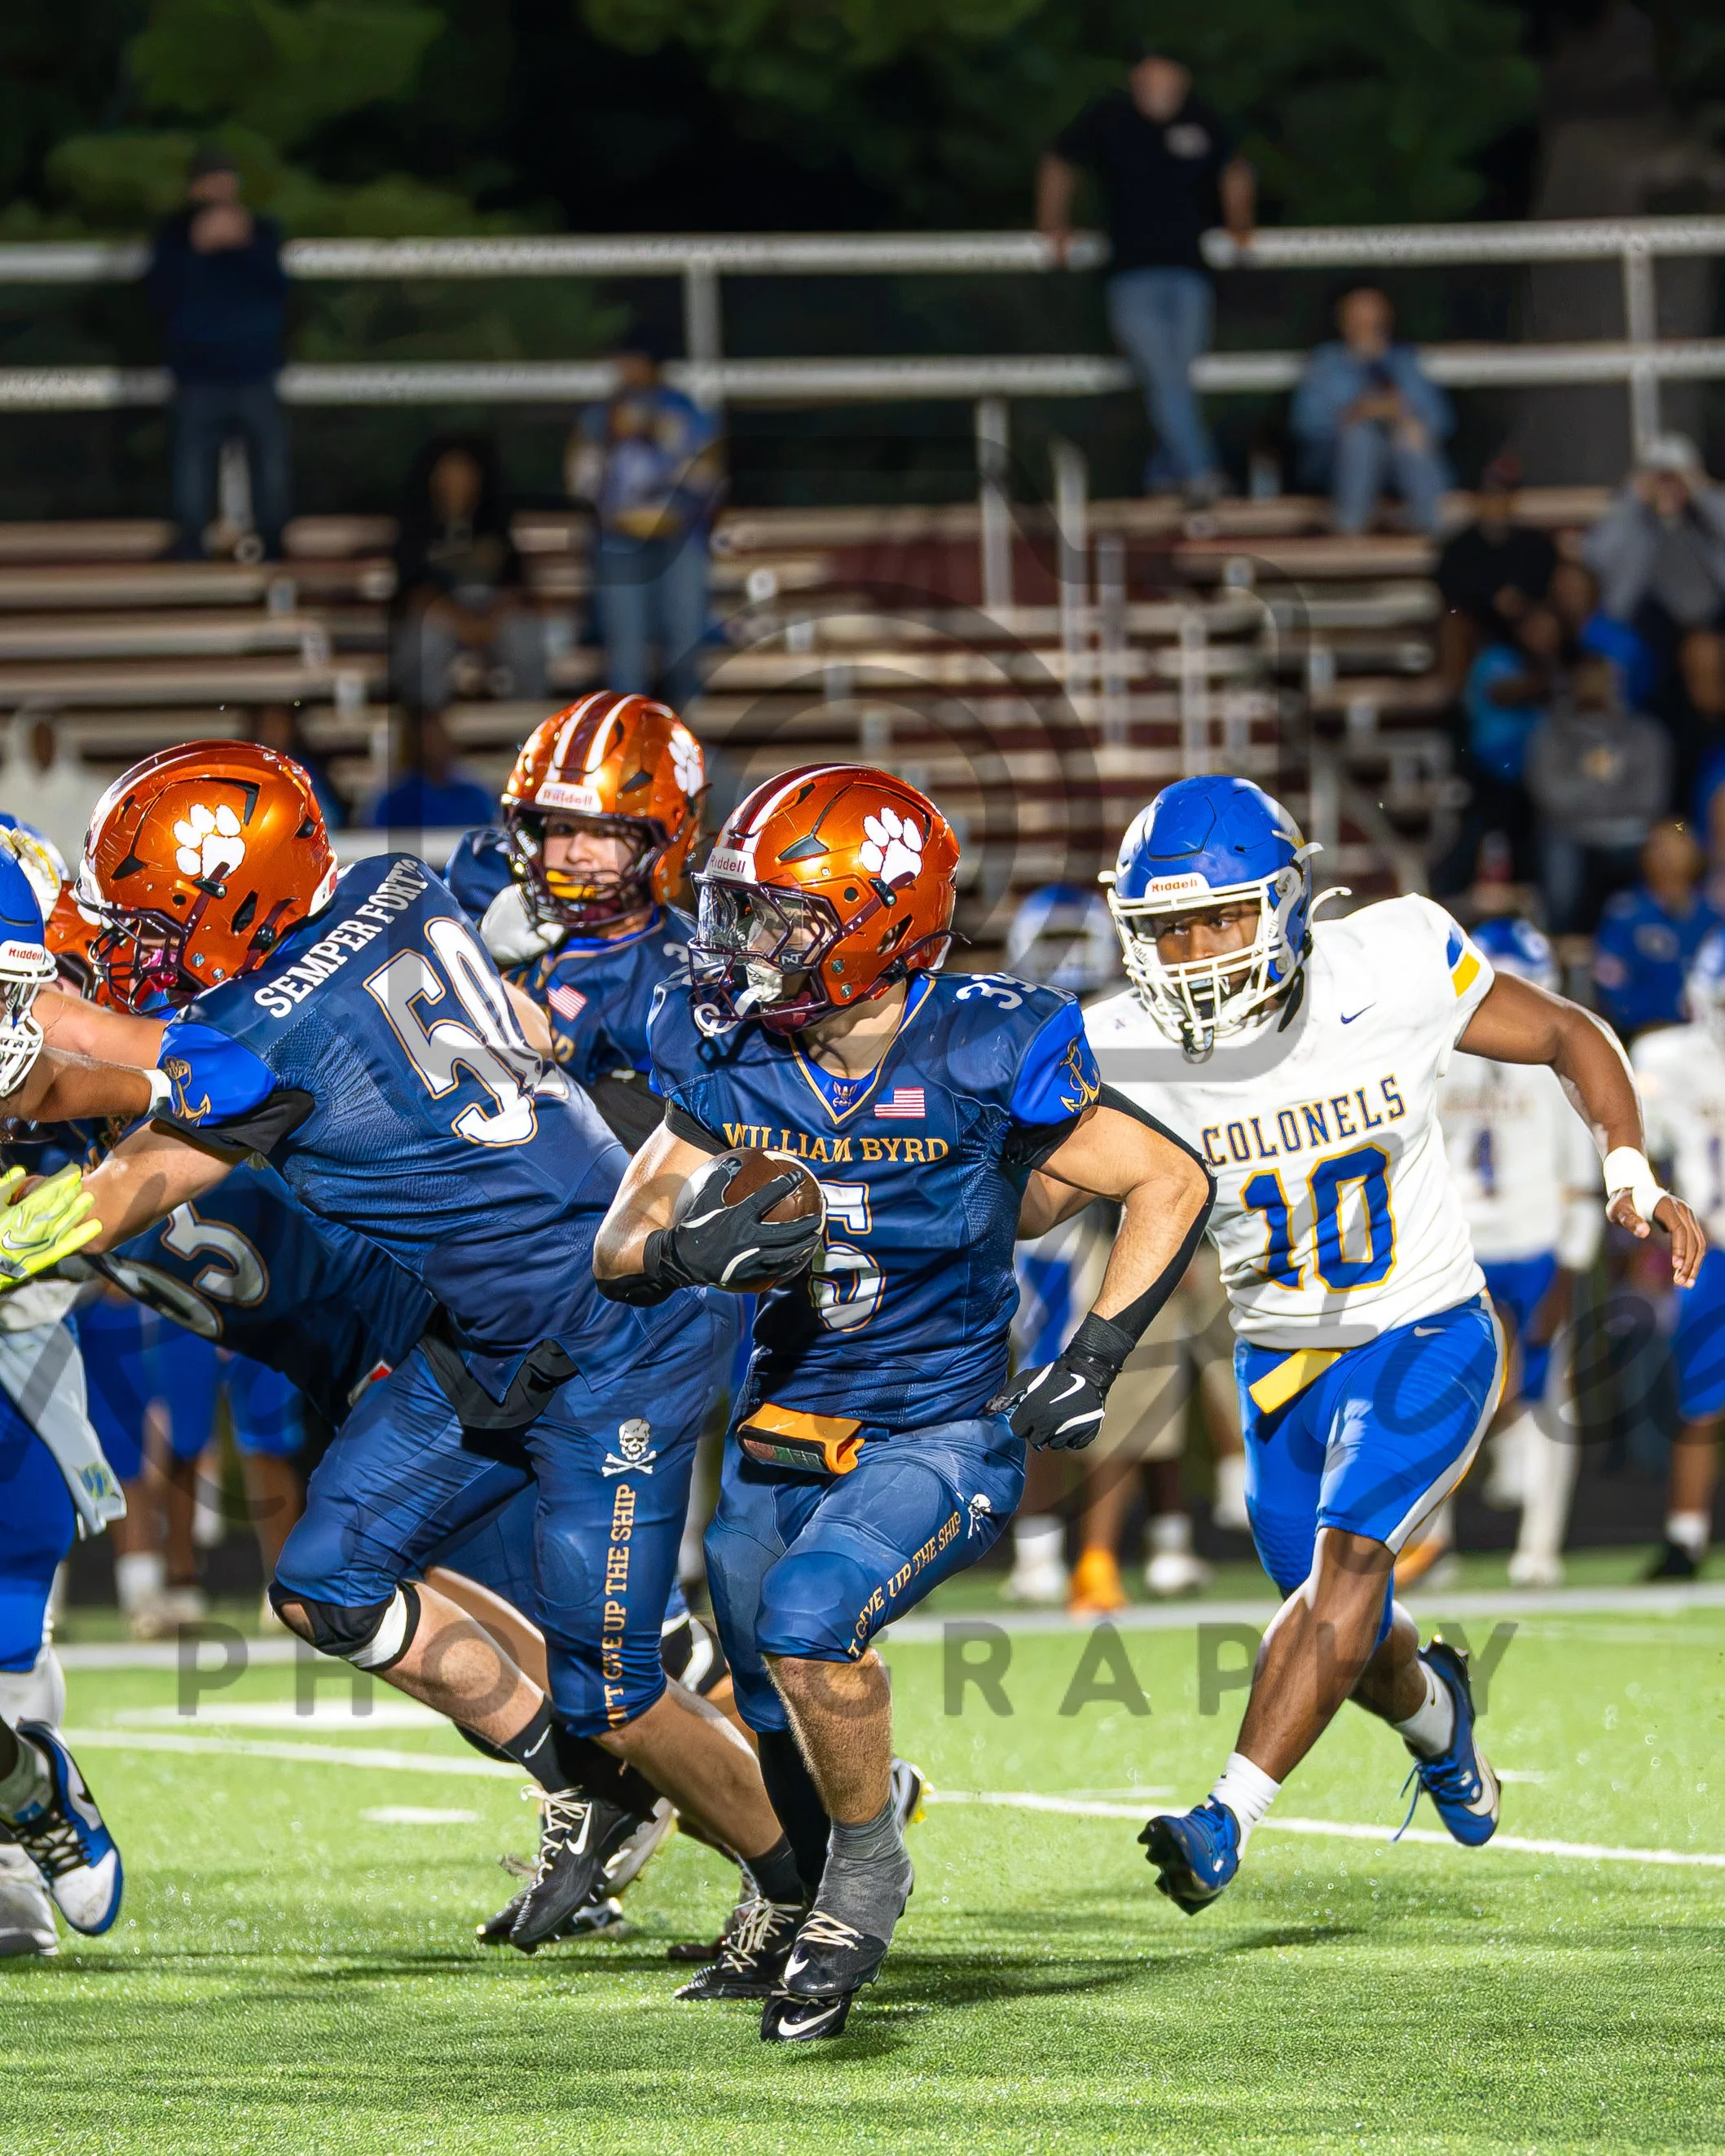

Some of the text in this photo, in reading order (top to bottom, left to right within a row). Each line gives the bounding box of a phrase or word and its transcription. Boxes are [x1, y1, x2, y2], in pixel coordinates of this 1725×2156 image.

[710, 854, 746, 873] Riddell
[1151, 878, 1198, 893] Riddell
[253, 918, 384, 1019] SEMPER
[722, 1123, 949, 1163] WILLIAM BYRD
[1200, 1073, 1406, 1168] COLONELS
[1239, 1142, 1397, 1294] 10
[610, 1484, 636, 1542] SHIP
[605, 1547, 630, 1595] THE
[887, 1563, 912, 1598] UP
[912, 1536, 938, 1577] THE
[937, 1511, 962, 1551] SHIP
[603, 1599, 627, 1631] UP
